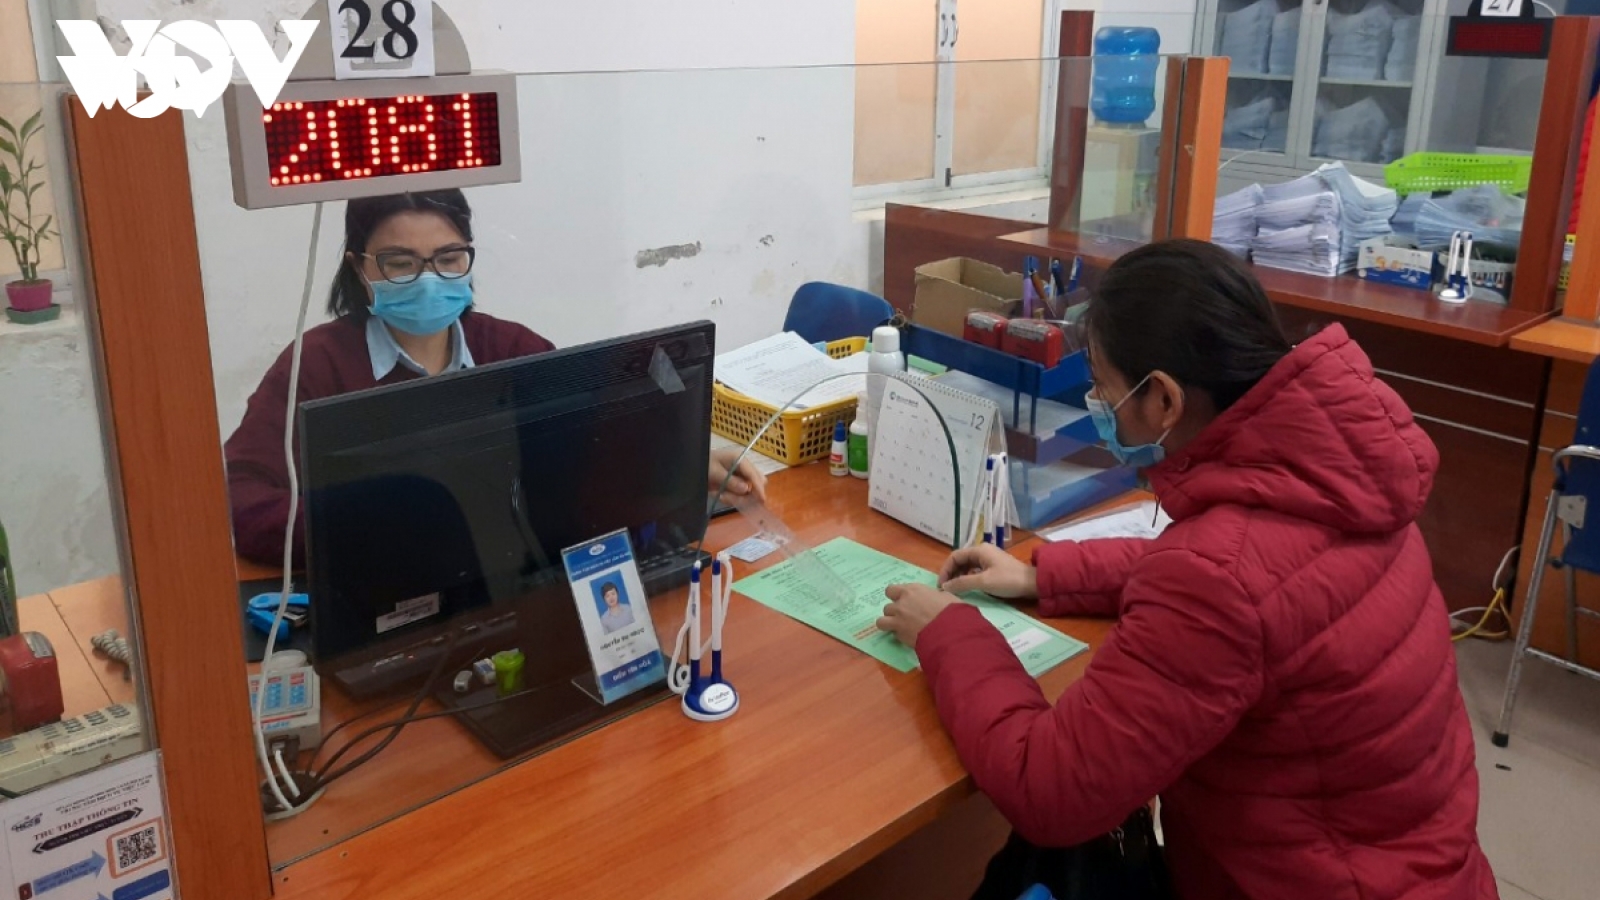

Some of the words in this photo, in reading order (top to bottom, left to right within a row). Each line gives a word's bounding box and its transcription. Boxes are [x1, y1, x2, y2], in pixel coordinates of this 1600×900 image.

[338, 0, 418, 59] 28
[263, 92, 483, 184] 2081
[969, 412, 985, 431] 12
